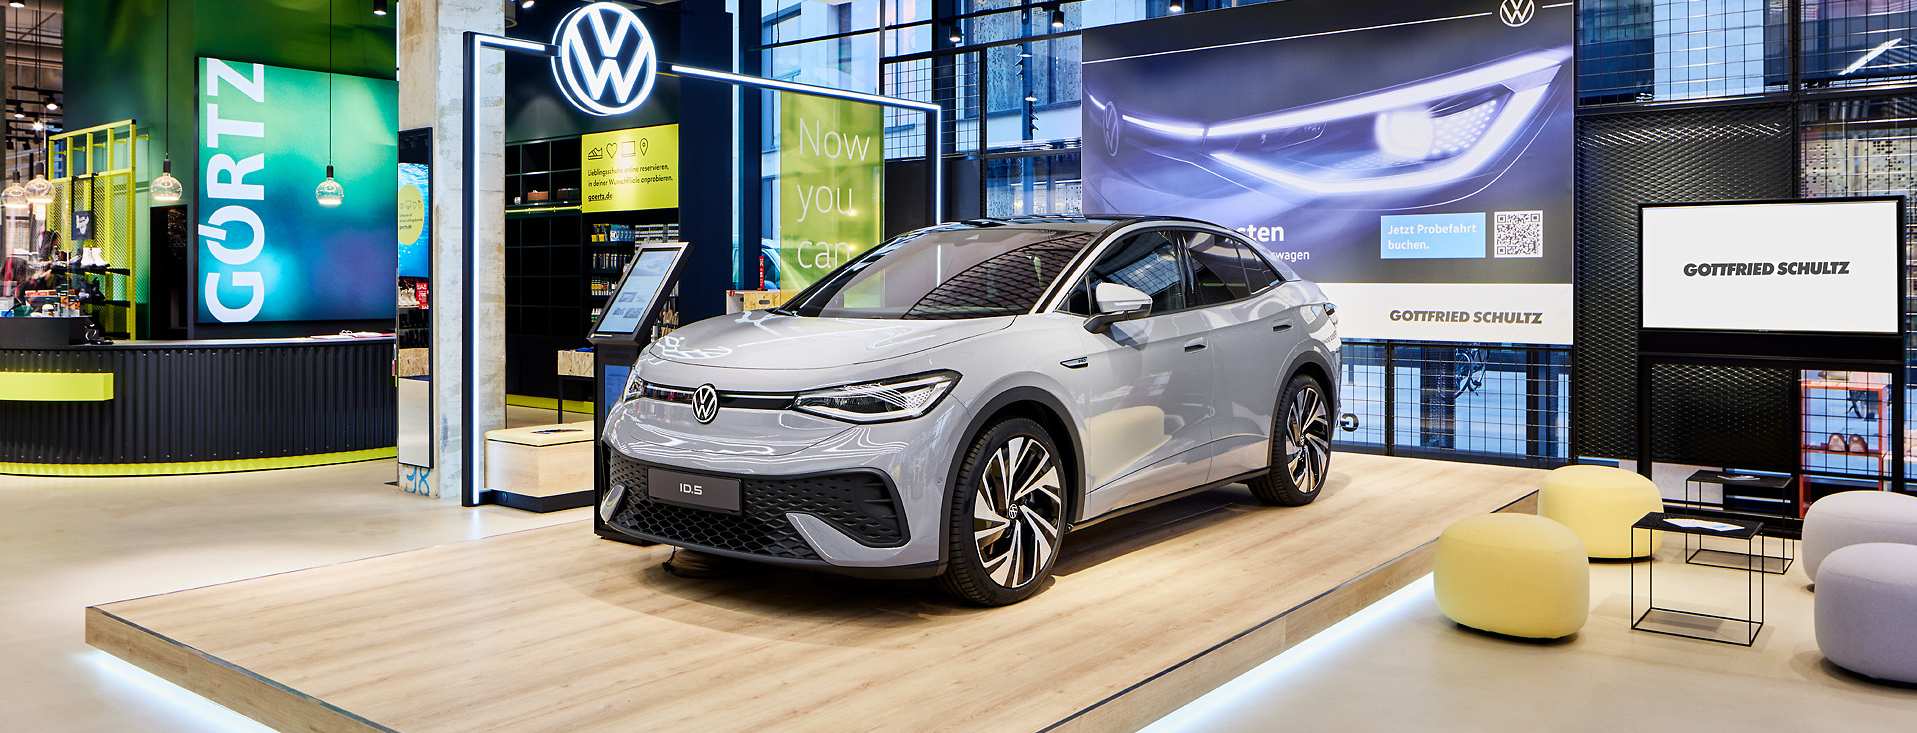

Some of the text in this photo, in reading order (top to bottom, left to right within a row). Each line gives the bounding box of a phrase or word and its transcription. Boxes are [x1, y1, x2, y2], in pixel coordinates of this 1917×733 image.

[799, 117, 870, 161] Now
[796, 184, 852, 223] you
[1387, 223, 1478, 236] Jetzt Probefahrt
[1387, 239, 1430, 251] buchen.
[797, 240, 851, 269] can
[1683, 261, 1851, 277] GOTTFRIED SCHULTZ
[1389, 309, 1544, 325] GOTTFRIED SCHULTZ
[679, 482, 703, 496] ID.5
